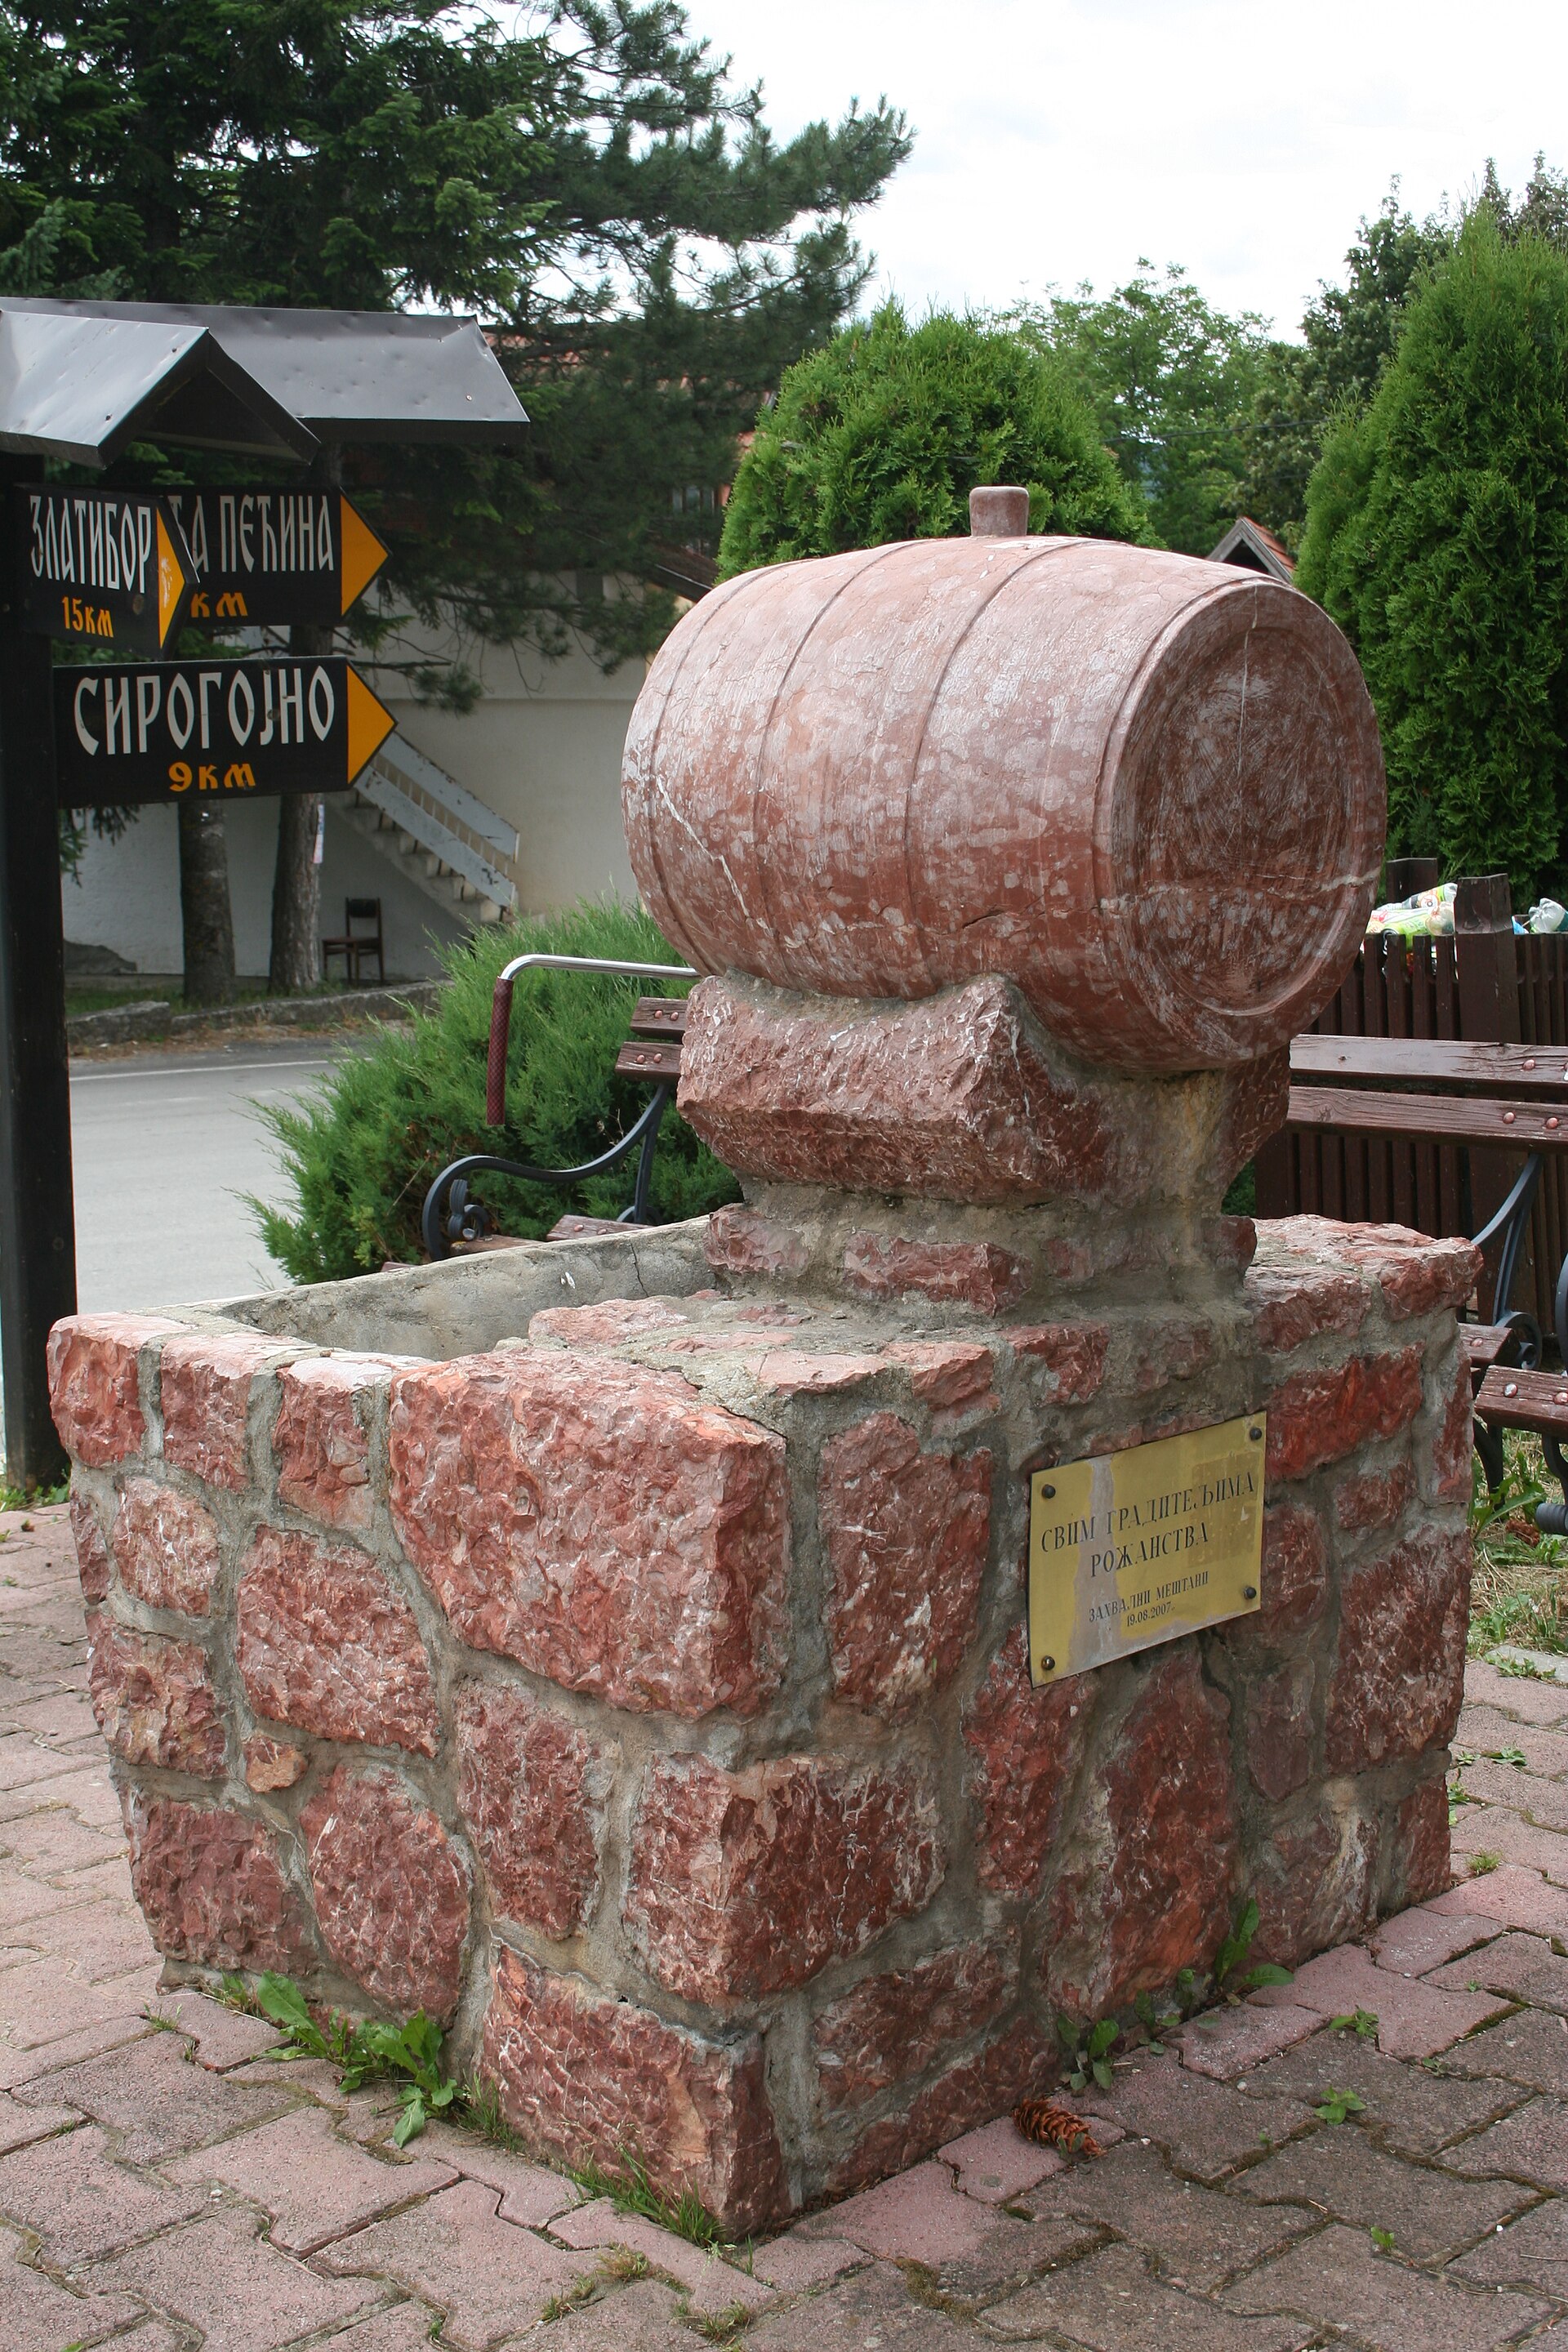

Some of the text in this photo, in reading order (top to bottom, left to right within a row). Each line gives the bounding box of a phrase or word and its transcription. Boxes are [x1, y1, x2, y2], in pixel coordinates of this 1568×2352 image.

[29, 495, 151, 594] ЗЛАТИБОР
[220, 494, 334, 572] ПЕЋИНА
[74, 665, 335, 756] СИРОГОЈНО
[1041, 1472, 1254, 1552] СВИМ ГРАДИТЕЉИМА
[1090, 1522, 1209, 1578] РОЖАНСТВА
[1089, 1570, 1209, 1622] ЗАХВАЛНИ МЕШТАНИ
